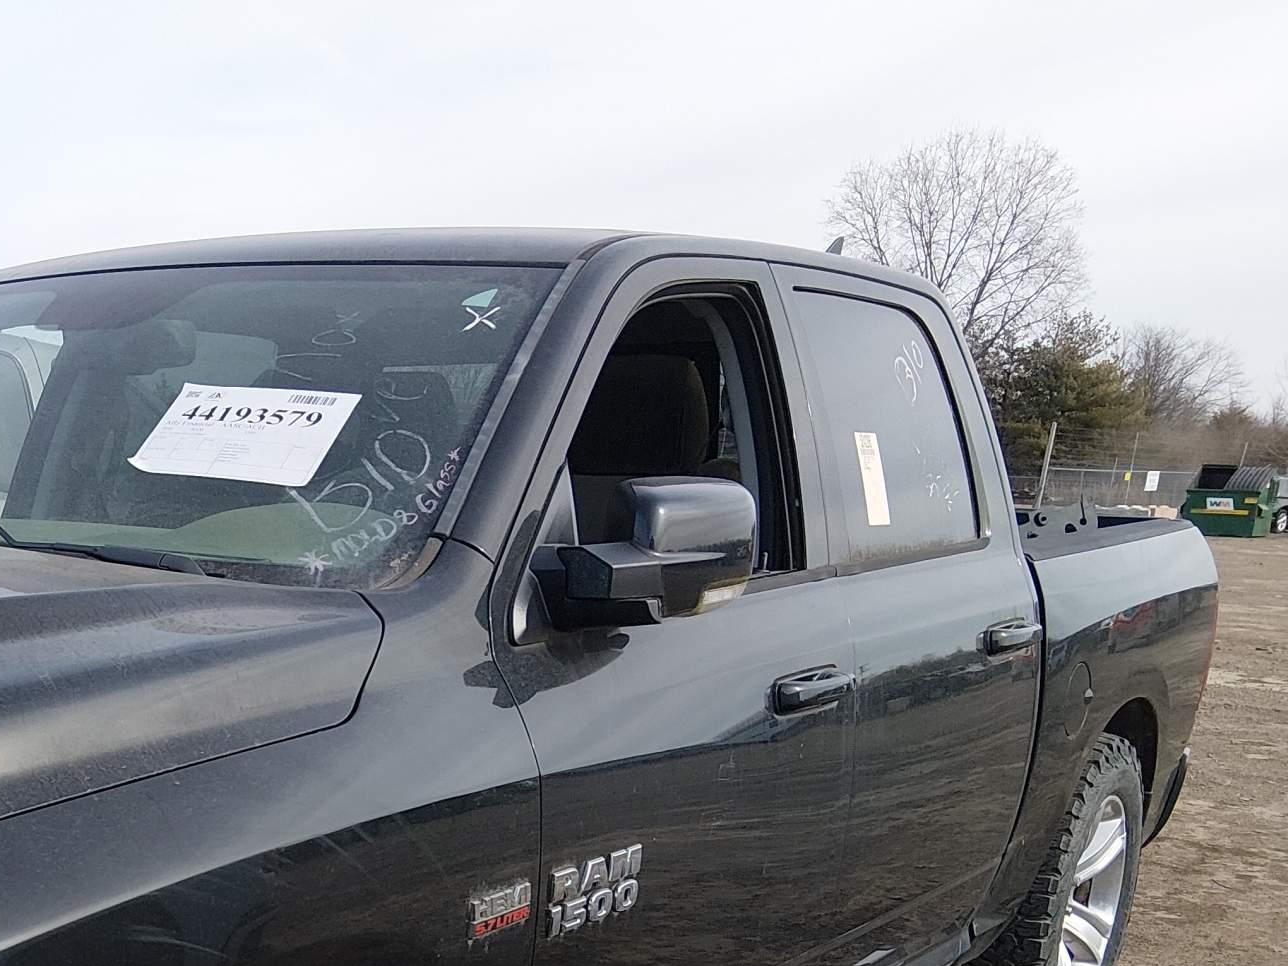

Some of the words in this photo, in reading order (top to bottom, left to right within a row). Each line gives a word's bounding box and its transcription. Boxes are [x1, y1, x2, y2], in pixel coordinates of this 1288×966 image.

[182, 405, 323, 428] 44193579
[549, 843, 643, 905] RAM
[470, 881, 532, 921] HEMI
[496, 906, 530, 929] LITER
[548, 878, 639, 938] 1500
